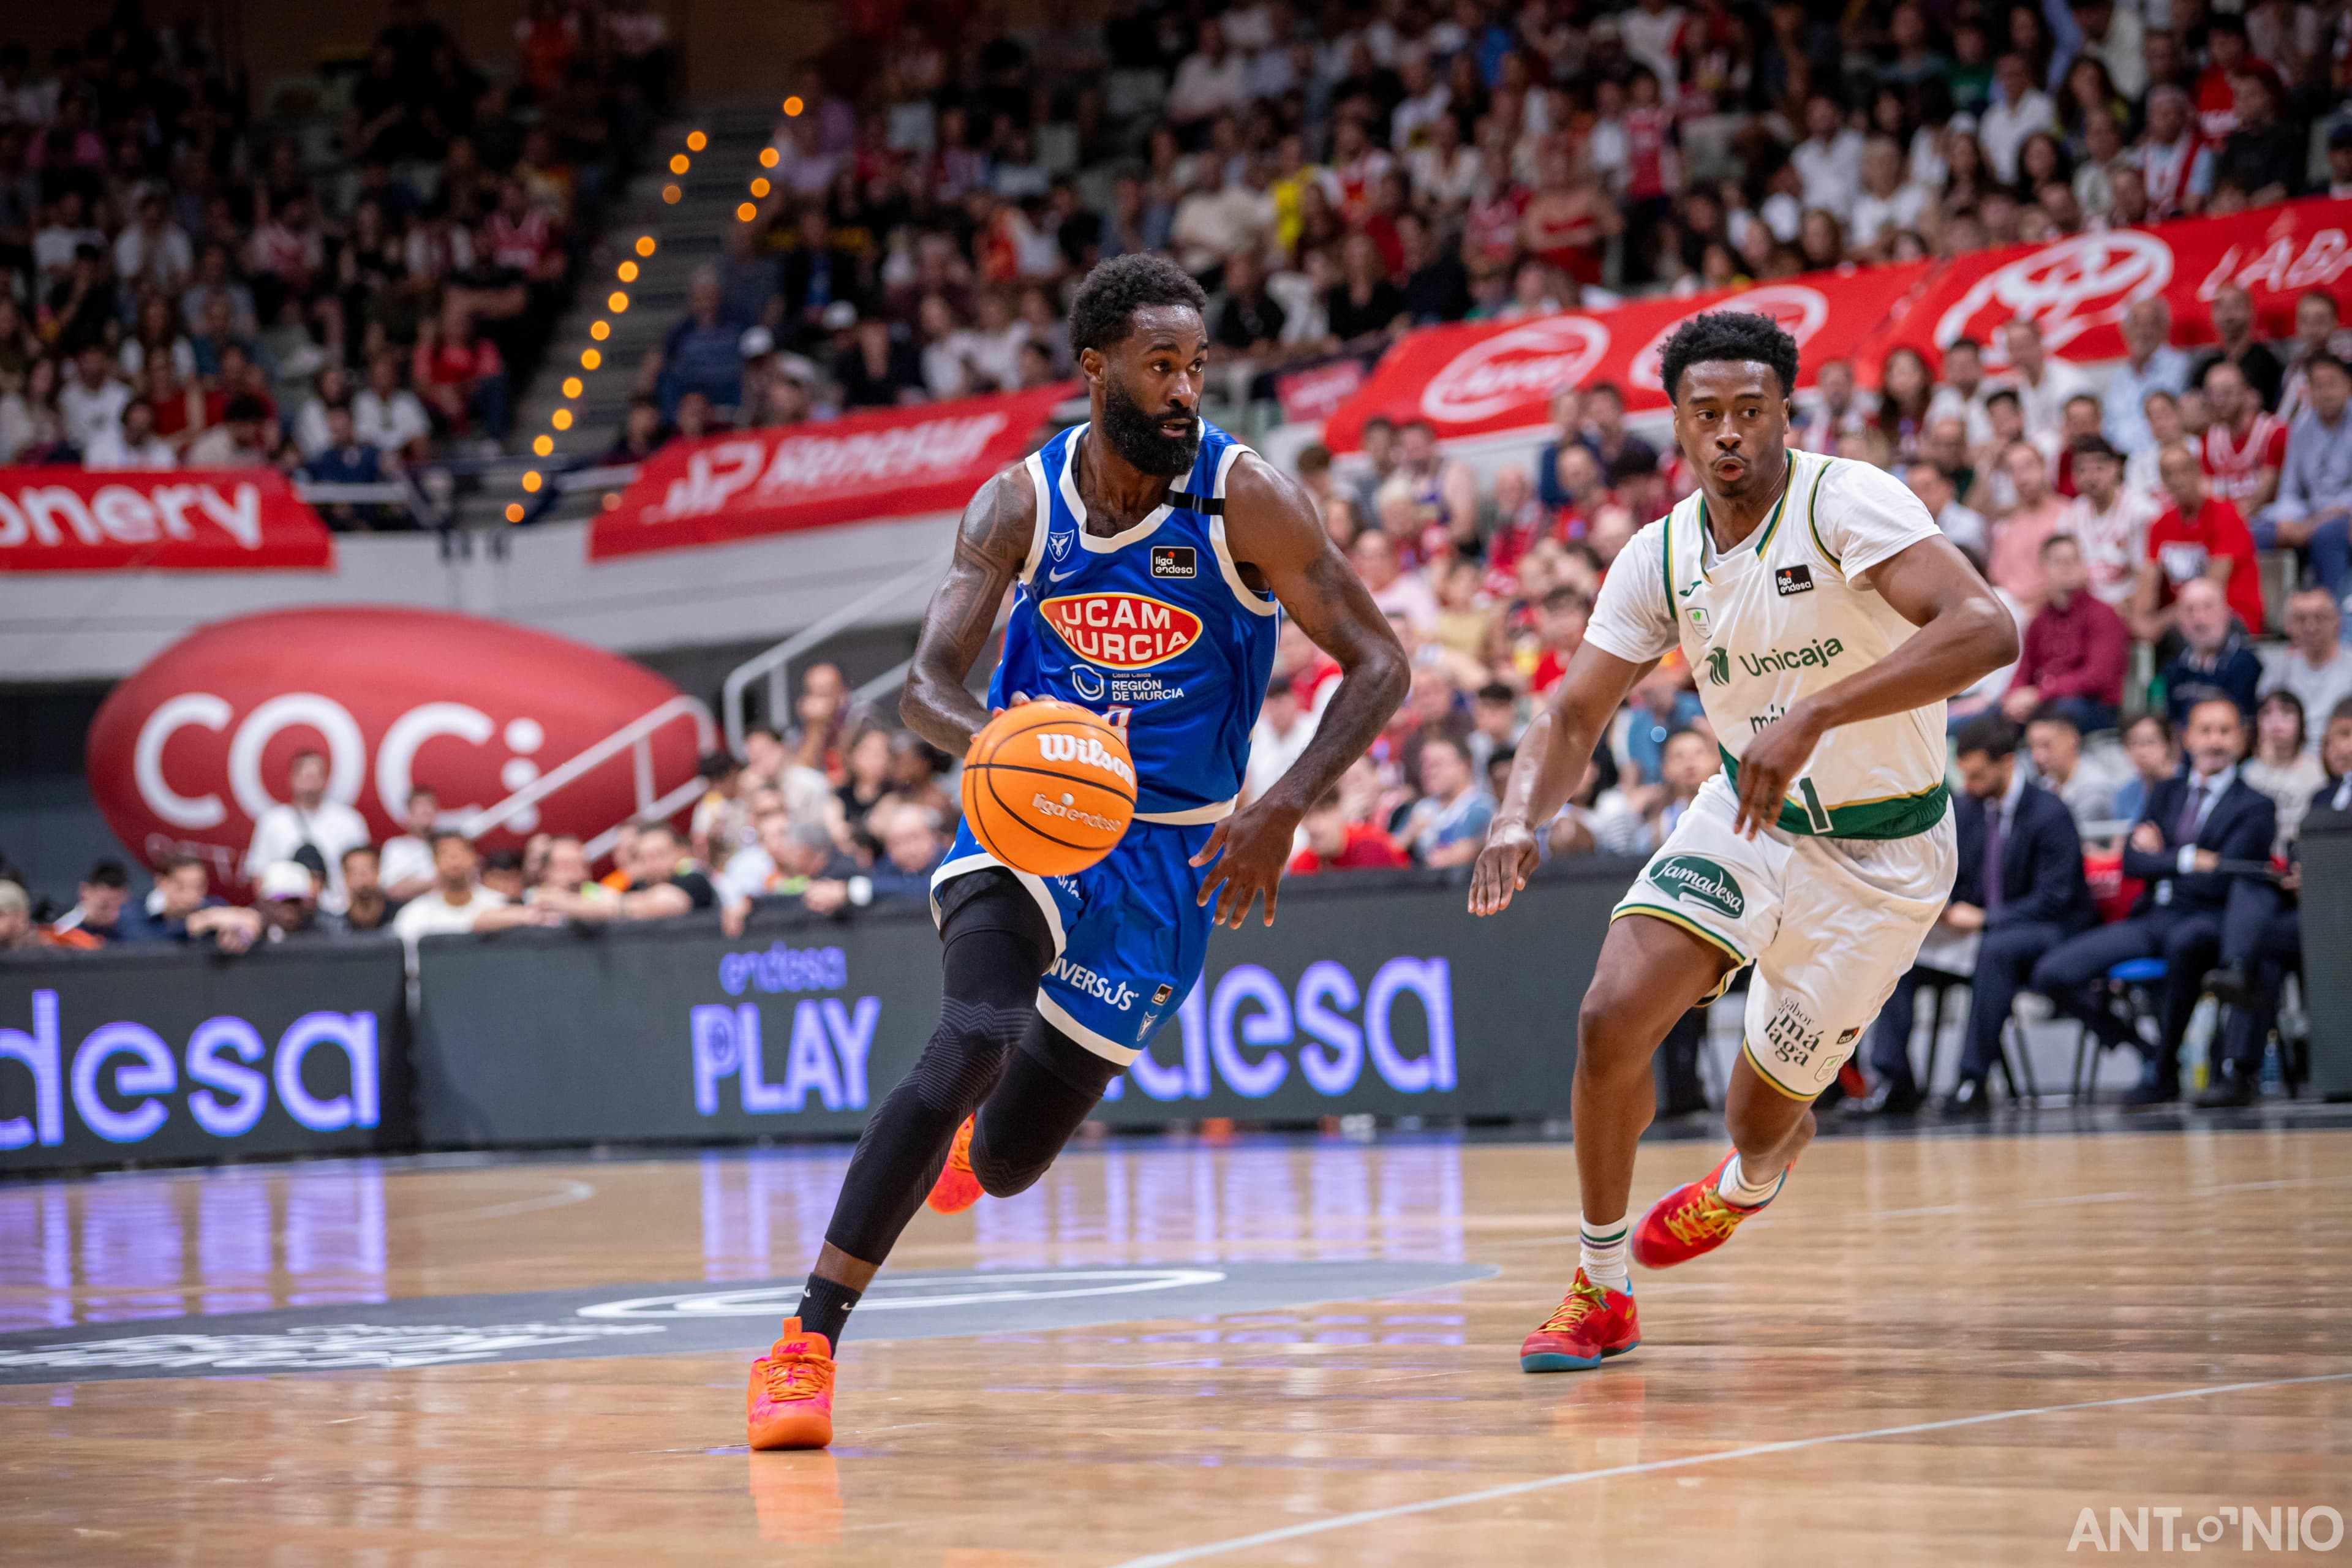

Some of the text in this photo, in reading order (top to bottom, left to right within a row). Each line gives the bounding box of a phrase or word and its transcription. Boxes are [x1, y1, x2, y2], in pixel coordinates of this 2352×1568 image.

[1155, 556, 1173, 566] liga
[1155, 565, 1193, 574] endesa
[1780, 581, 1812, 594] endesa
[1061, 599, 1170, 630] UCAM
[1055, 619, 1189, 662] MURCIA
[1738, 638, 1844, 677] Unicaja
[1111, 679, 1162, 691] REGIÓN
[1112, 687, 1185, 701] DE MURCIA
[1036, 733, 1134, 790] Wilson
[1102, 956, 1458, 1102] desa
[690, 995, 882, 1117] PLAY
